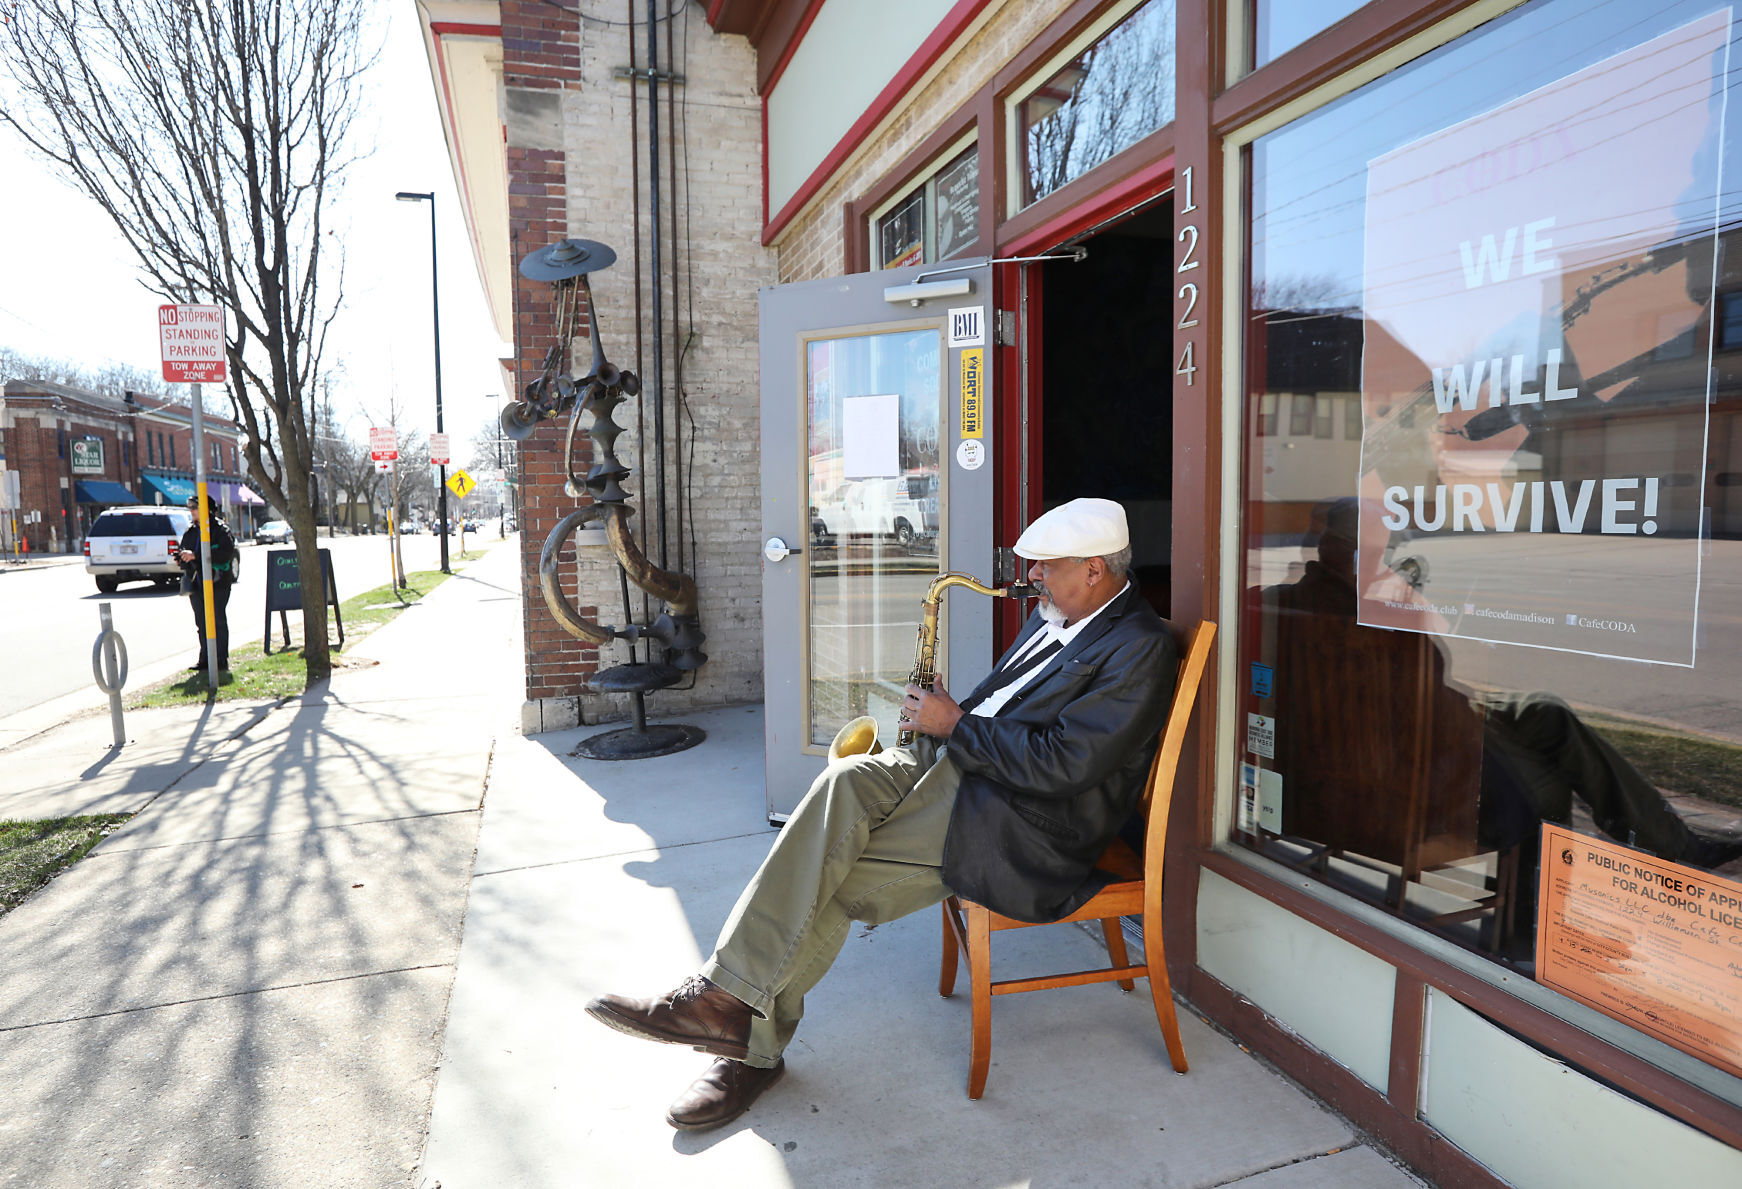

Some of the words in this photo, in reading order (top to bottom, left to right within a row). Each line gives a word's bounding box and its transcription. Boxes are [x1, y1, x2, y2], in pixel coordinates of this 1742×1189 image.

[1459, 216, 1556, 291] WE
[1176, 165, 1200, 387] 1224
[160, 308, 177, 325] NO
[178, 310, 220, 323] STOPPING
[954, 312, 978, 338] BMI
[165, 328, 219, 341] STANDING
[169, 345, 217, 357] PARKING
[171, 362, 189, 371] TOW
[192, 362, 217, 371] AWAY
[183, 371, 207, 380] ZONE
[965, 355, 980, 398] WORT
[1432, 347, 1579, 415] WILL
[966, 398, 977, 419] 89.9
[966, 419, 977, 433] FM
[1381, 477, 1660, 536] SURVIVE!
[1475, 607, 1555, 625] cafecodamadison
[1578, 617, 1637, 633] CafeCODA
[1587, 851, 1631, 875] PUBLIC
[1633, 867, 1683, 892] NOTICE
[1686, 884, 1705, 898] OF
[1612, 876, 1638, 894] FOR
[1640, 886, 1706, 917] ALCOHOL
